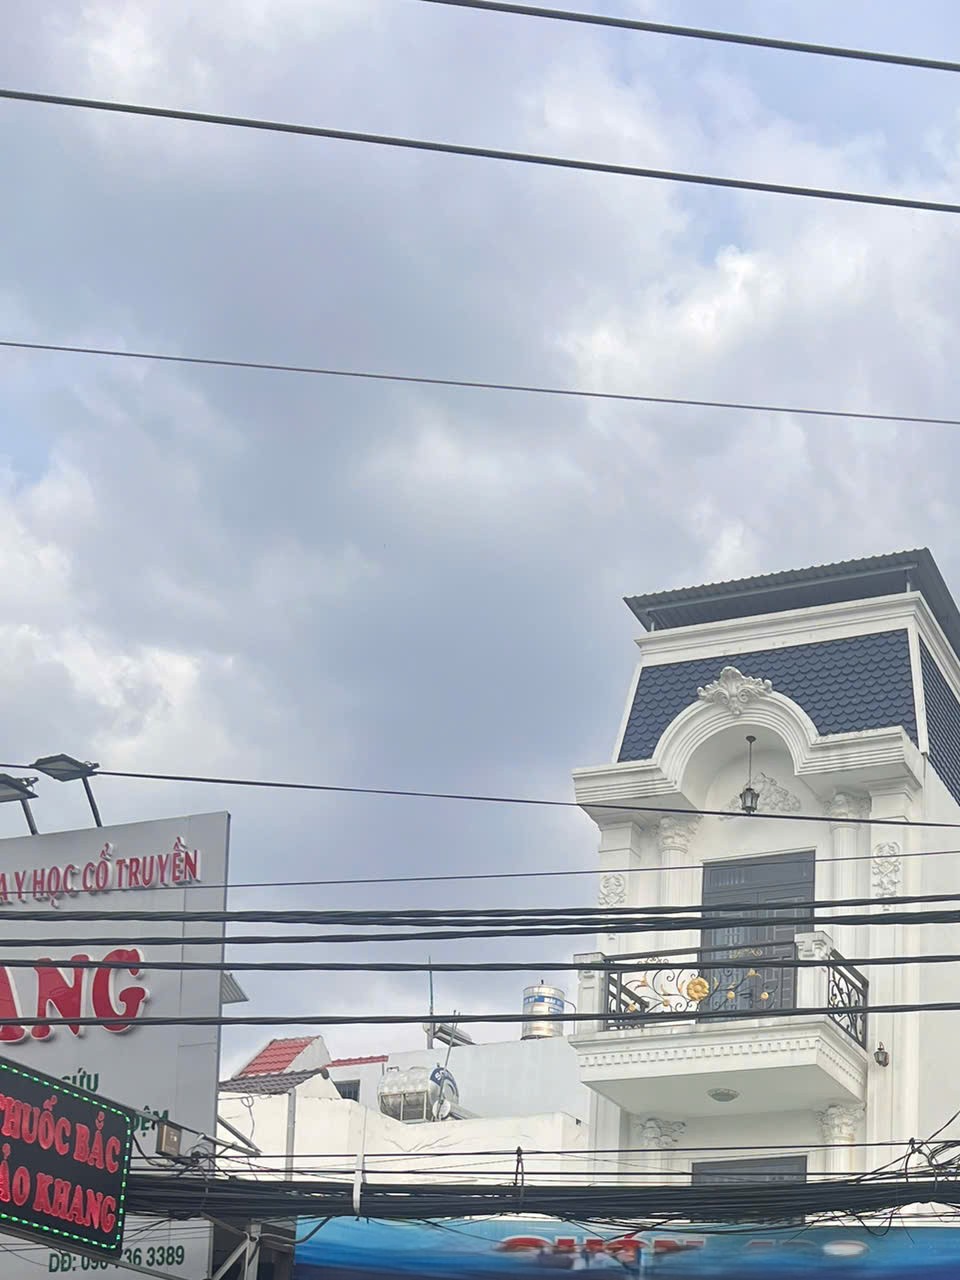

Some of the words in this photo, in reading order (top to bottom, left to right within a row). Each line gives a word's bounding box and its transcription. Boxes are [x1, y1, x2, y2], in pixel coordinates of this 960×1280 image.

[14, 870, 26, 900] Y
[32, 864, 75, 908] HỌC
[82, 842, 111, 891] CỔ
[115, 836, 198, 888] TRUYỀN
[73, 1111, 121, 1173] BẮC
[33, 1172, 116, 1233] KHANG
[146, 1245, 185, 1266] 3389
